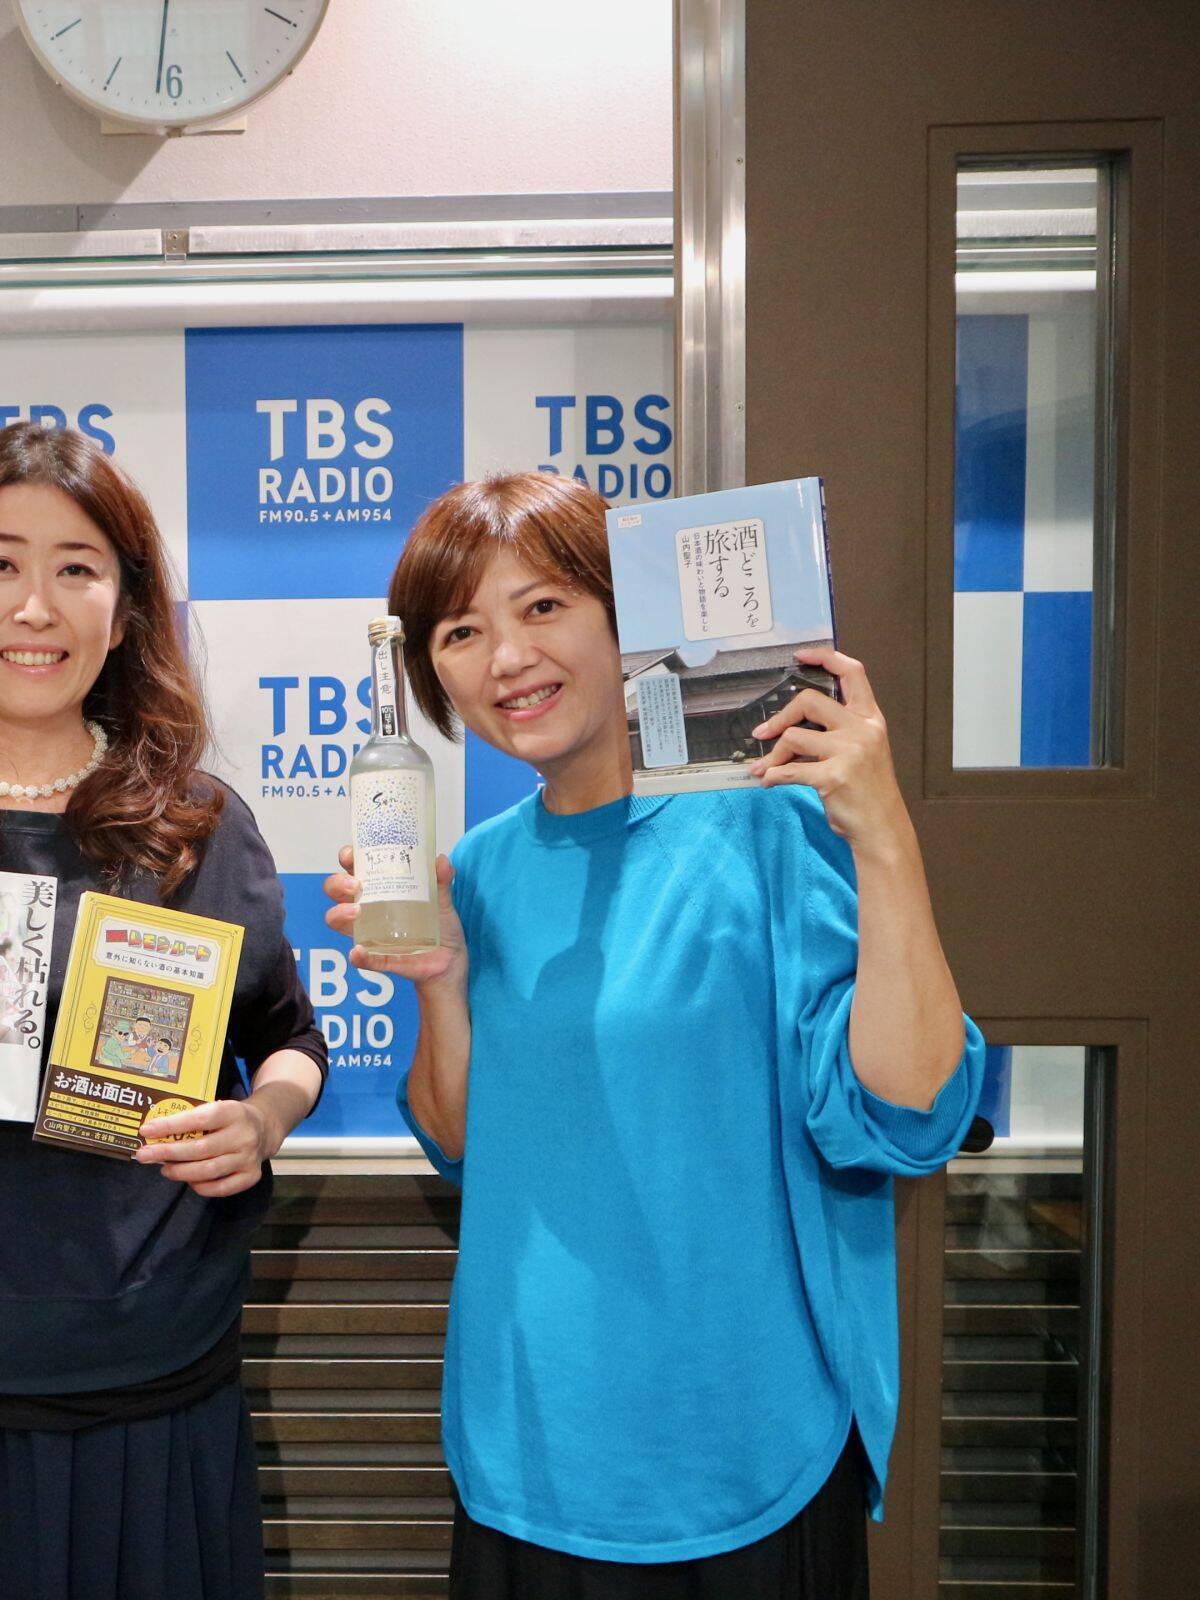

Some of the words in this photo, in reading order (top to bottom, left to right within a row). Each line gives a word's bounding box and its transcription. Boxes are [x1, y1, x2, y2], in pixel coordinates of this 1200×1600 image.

[165, 64, 184, 99] 6
[256, 397, 394, 462] TBS
[535, 394, 672, 458] TBS
[259, 466, 394, 504] RADIO
[704, 529, 731, 598] 旅する
[731, 524, 759, 628] 酒どころを
[261, 744, 361, 779] RAD
[14, 880, 54, 1050] 美しく枯れる。
[105, 951, 205, 980] 意外に知らない酒の基本知識
[293, 947, 395, 1008] BS
[321, 1013, 394, 1049] DIO
[53, 1071, 156, 1111] お酒は面白い。
